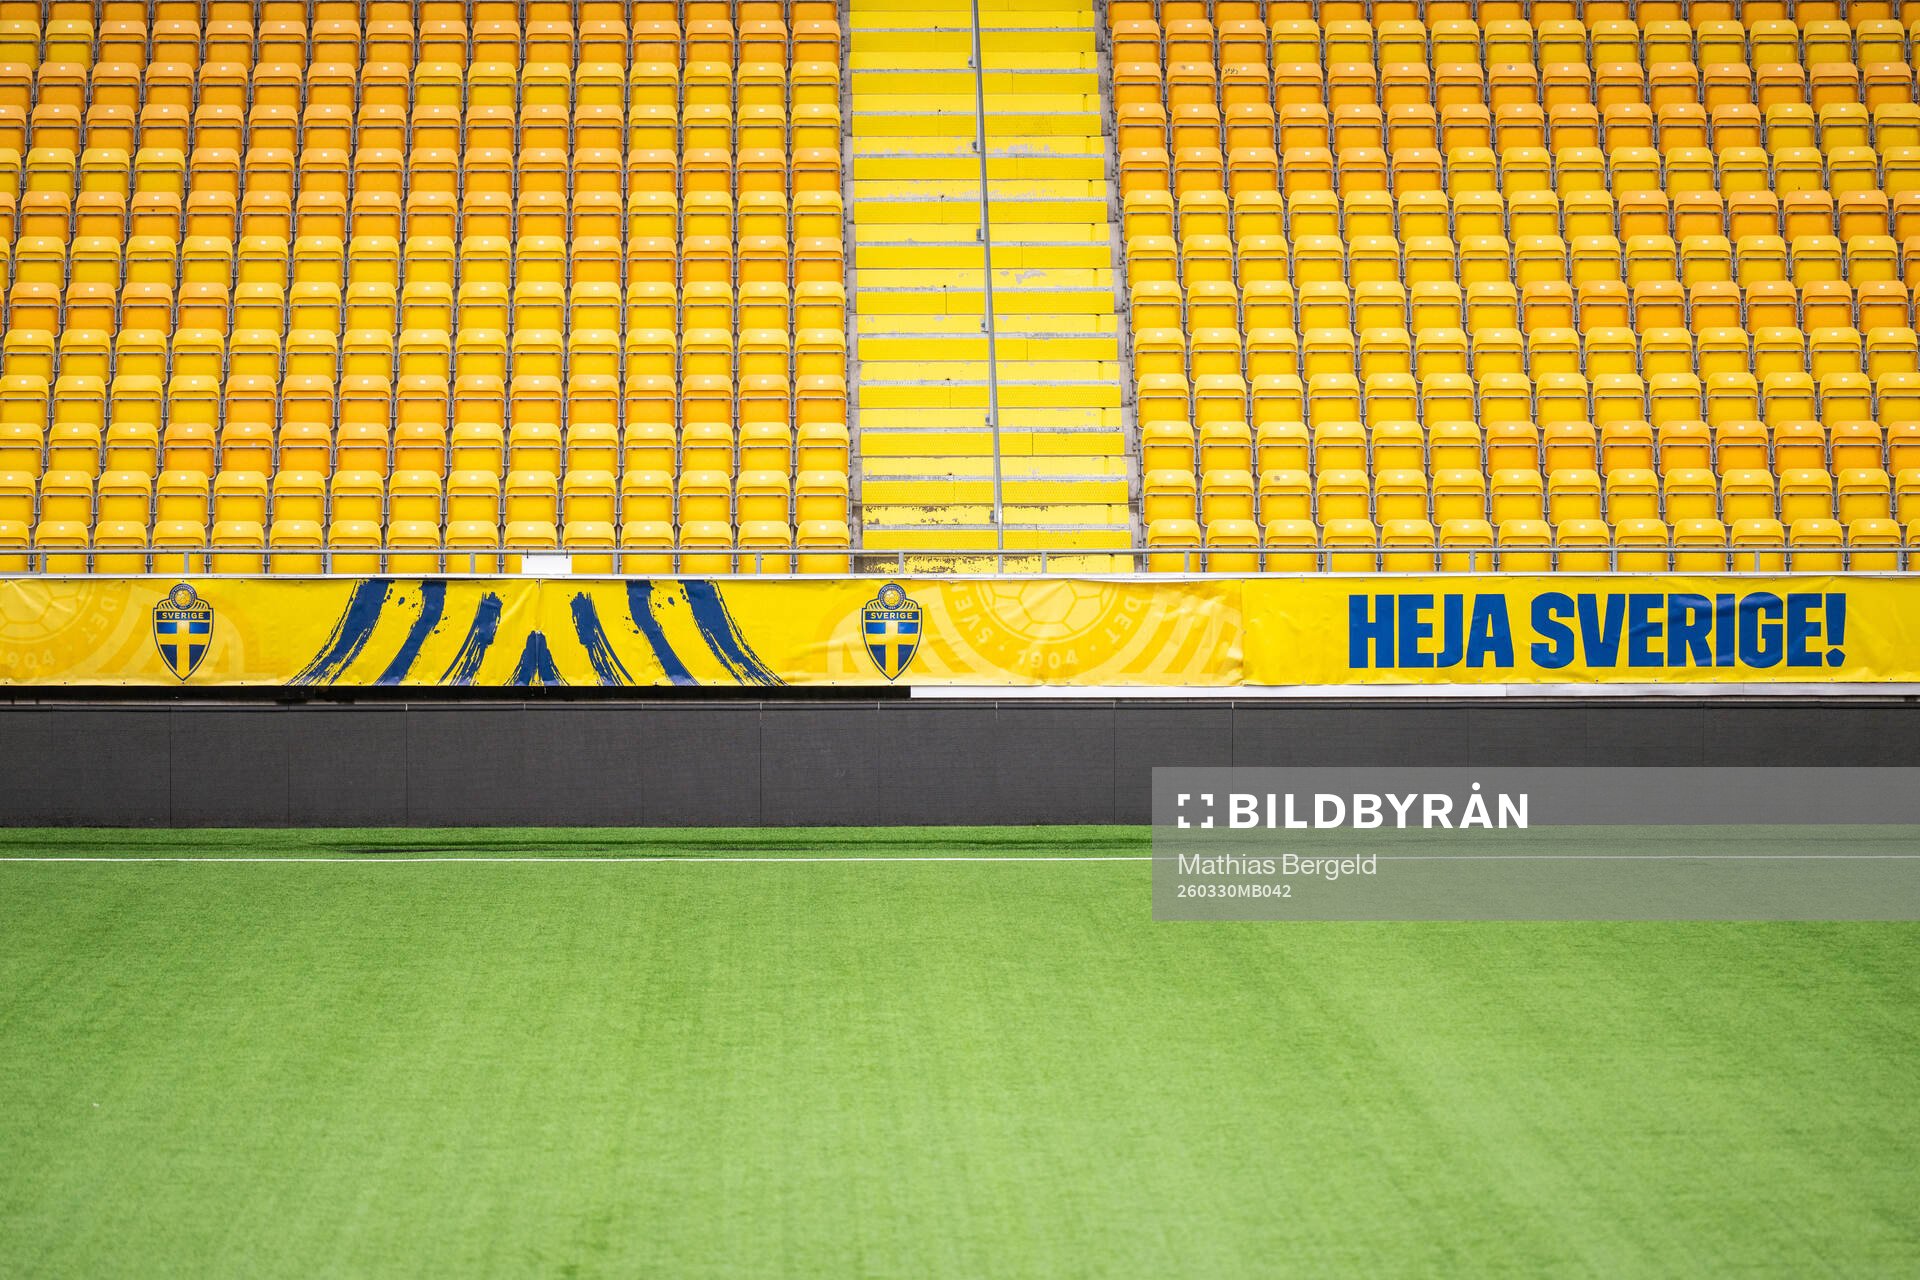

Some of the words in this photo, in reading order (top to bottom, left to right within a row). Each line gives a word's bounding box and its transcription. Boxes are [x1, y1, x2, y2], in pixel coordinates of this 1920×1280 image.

[1349, 594, 1514, 668] HEJA
[1531, 592, 1846, 669] SVERIGE!
[1017, 648, 1079, 669] 1904
